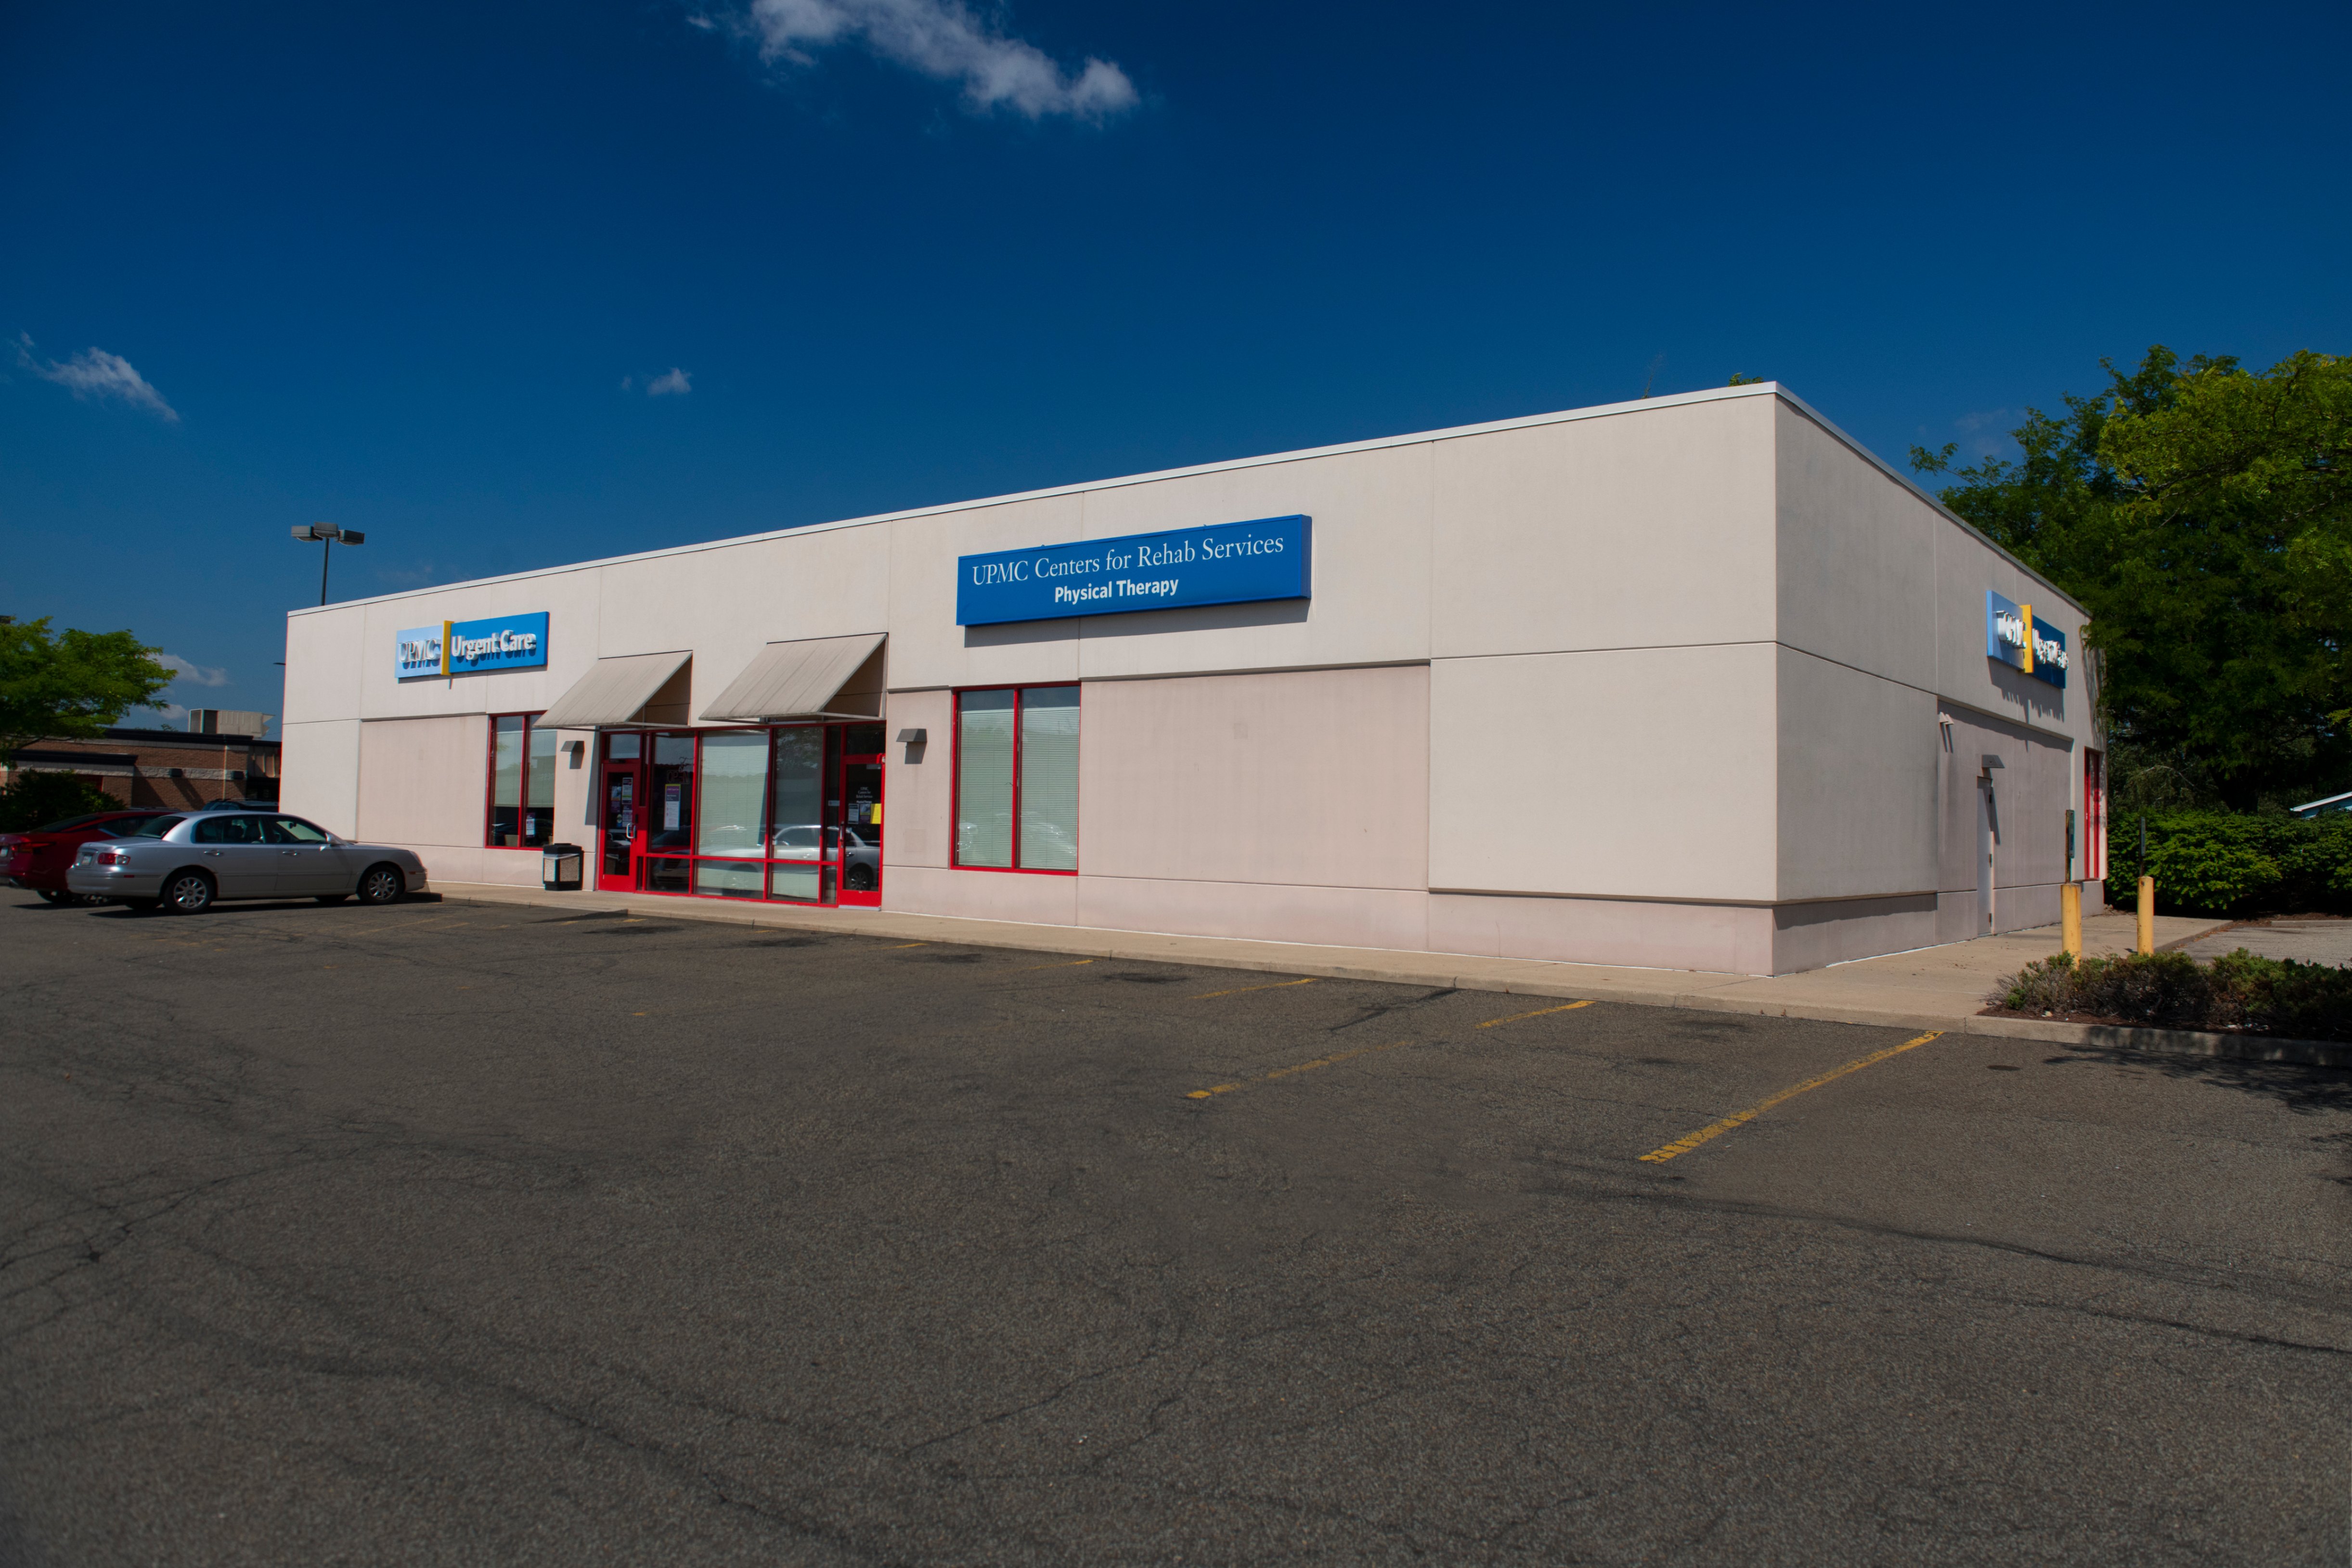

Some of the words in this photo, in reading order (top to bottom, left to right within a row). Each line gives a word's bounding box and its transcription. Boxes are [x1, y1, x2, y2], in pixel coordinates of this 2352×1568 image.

[972, 560, 1028, 585] UPMC
[1035, 558, 1100, 578] Centers
[1106, 549, 1131, 570] for
[1137, 540, 1195, 567] Rehab
[1202, 534, 1283, 560] Services
[1055, 581, 1112, 605] Physical
[1116, 579, 1179, 597] Therapy
[398, 638, 442, 663] UPMC
[452, 633, 501, 661] Urgent
[500, 630, 537, 652] Care
